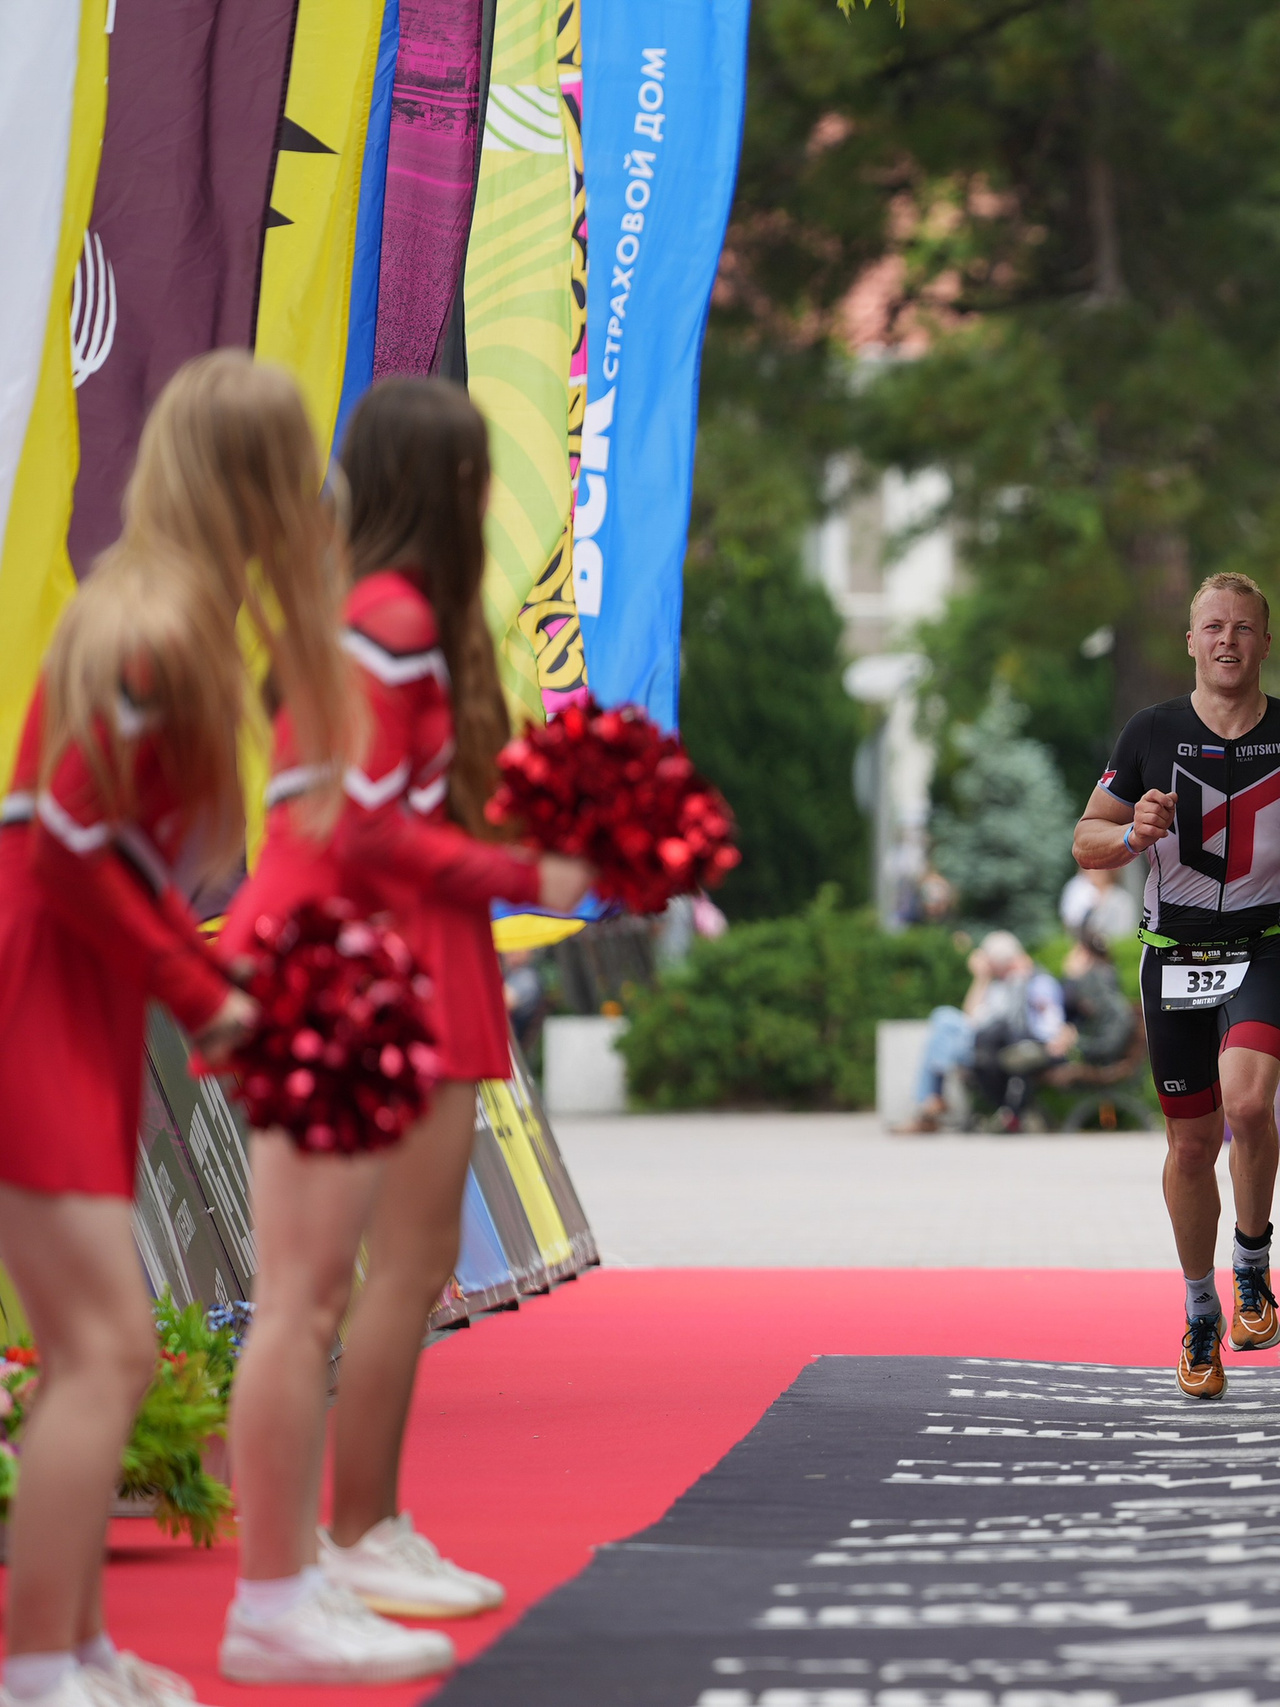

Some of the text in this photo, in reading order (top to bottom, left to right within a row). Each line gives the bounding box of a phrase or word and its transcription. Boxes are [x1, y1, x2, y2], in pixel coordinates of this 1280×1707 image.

[603, 150, 656, 381] СТРАХОВОЙ
[633, 48, 667, 142] ДОМ
[1187, 970, 1227, 993] 332
[1192, 997, 1217, 1006] DMITRIY
